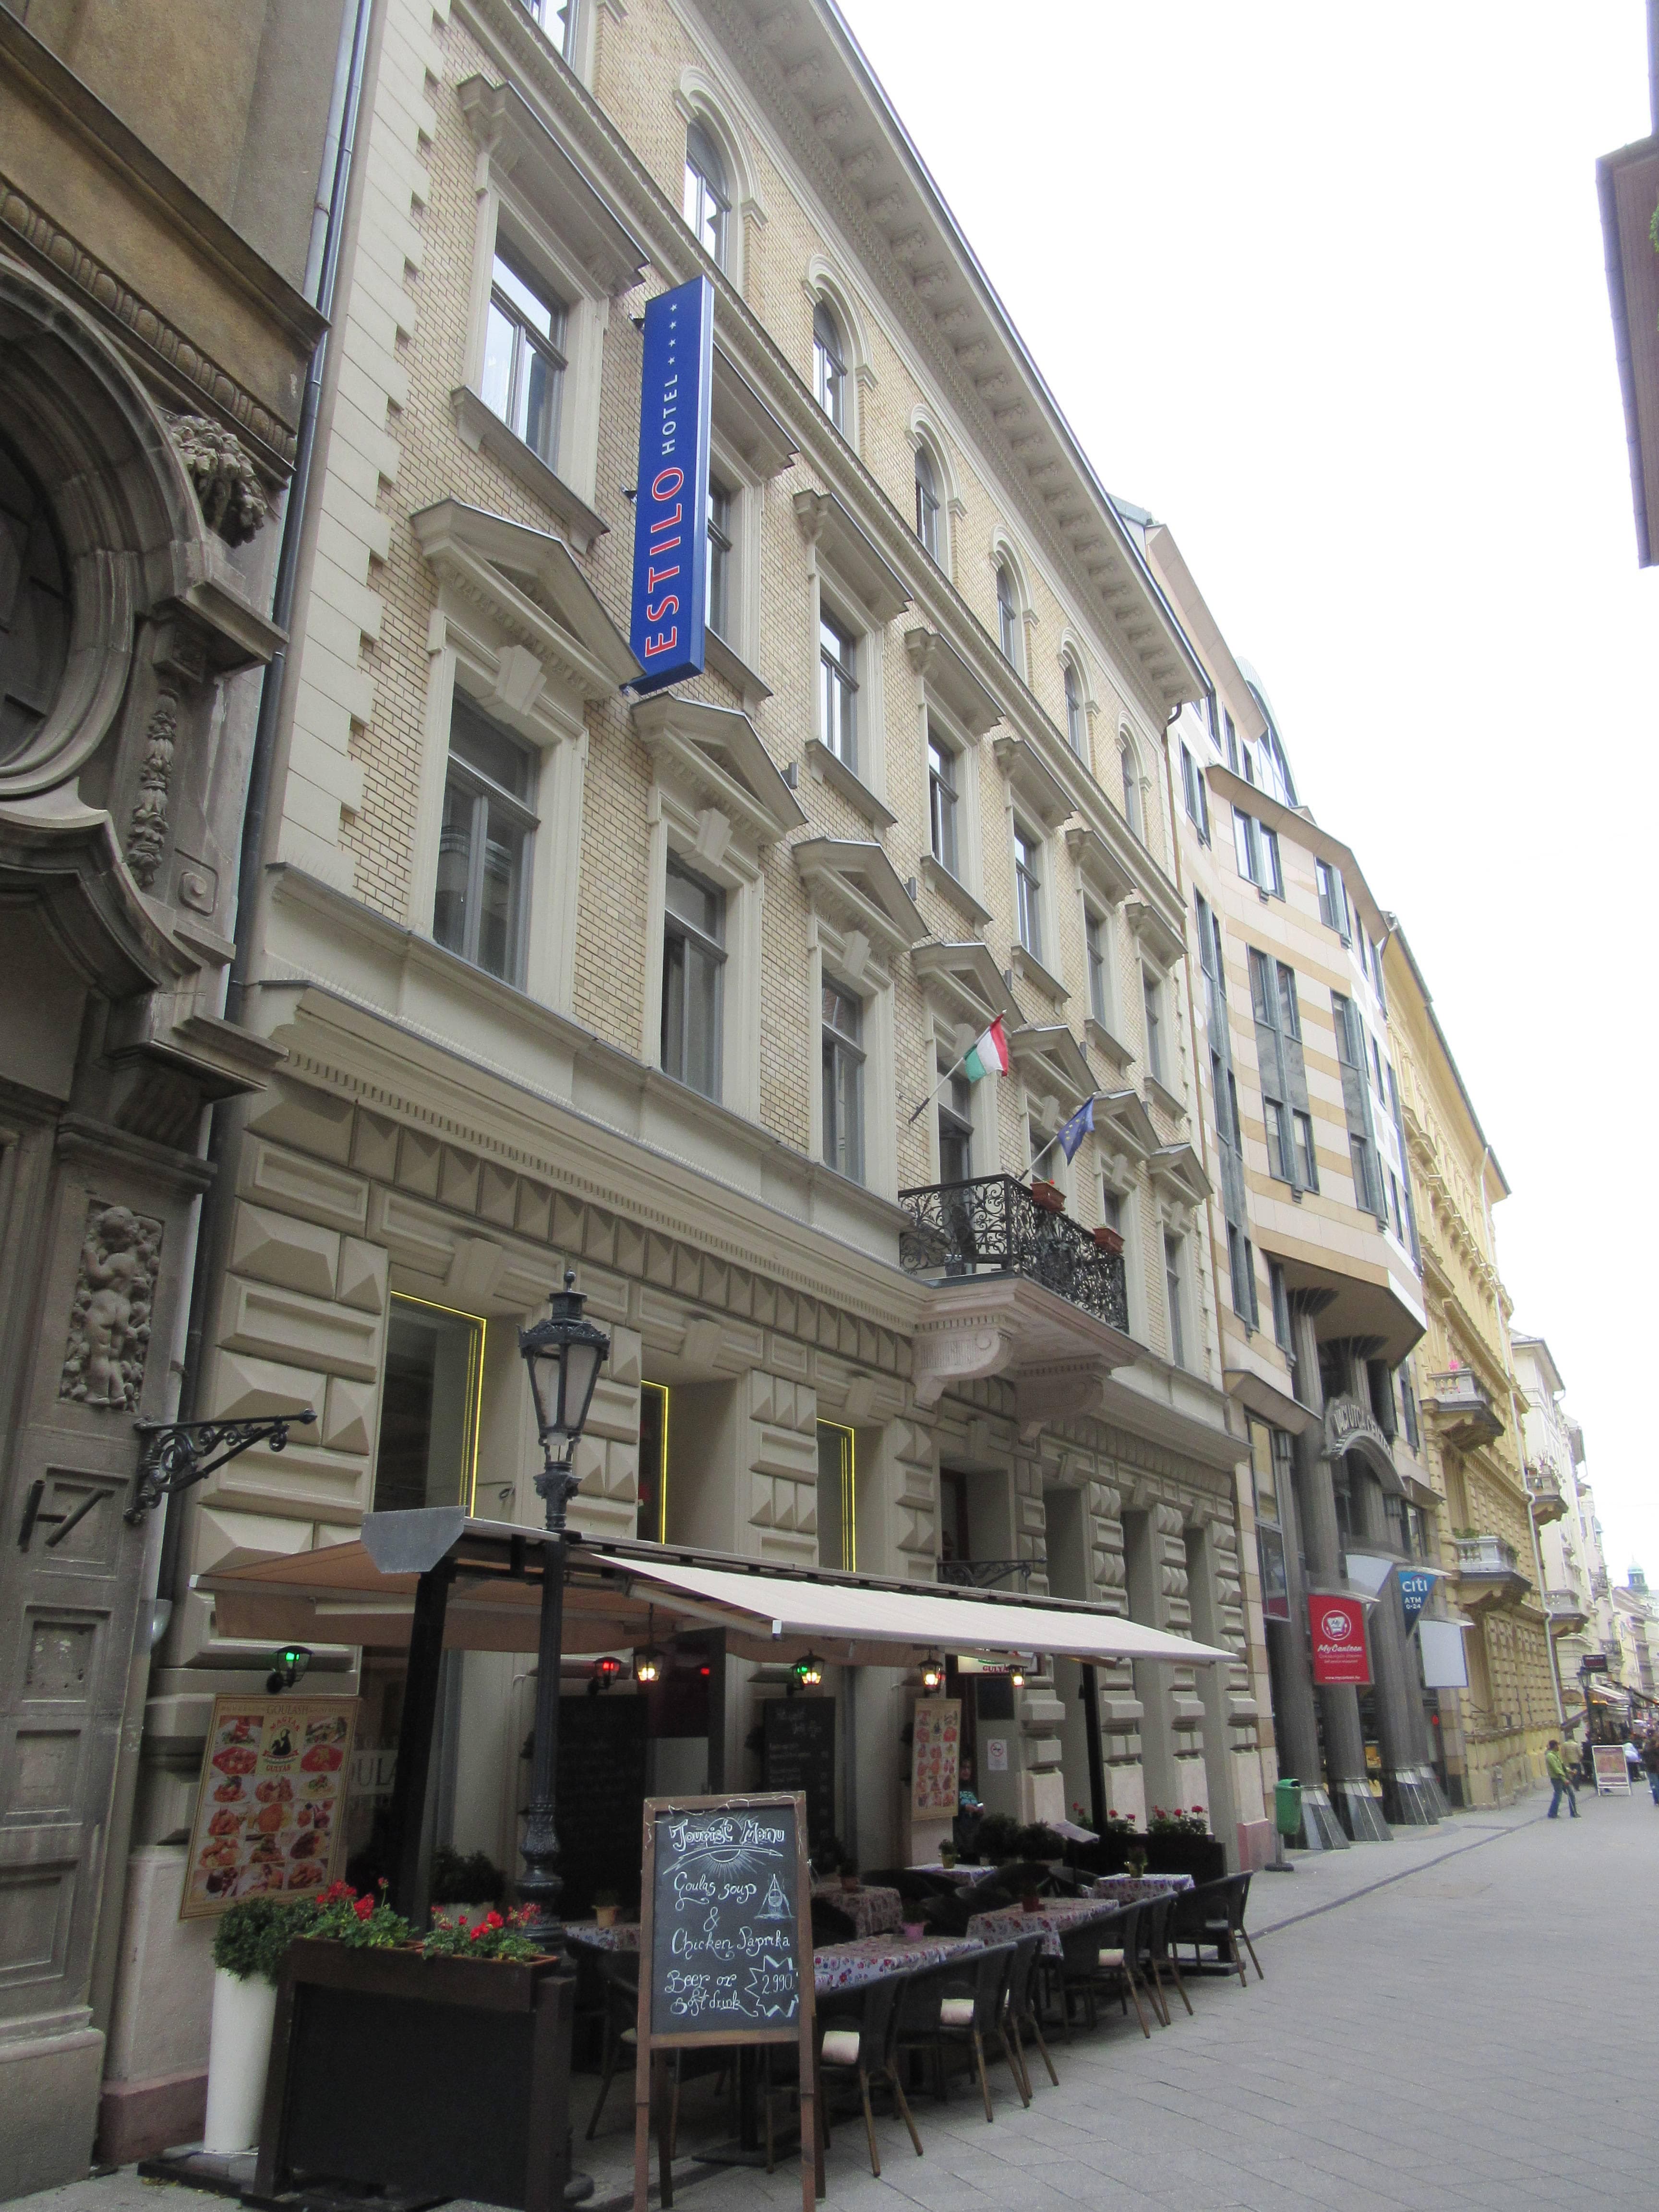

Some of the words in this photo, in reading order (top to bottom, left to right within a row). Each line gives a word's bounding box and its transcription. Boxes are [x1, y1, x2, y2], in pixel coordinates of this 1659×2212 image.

[662, 374, 678, 456] HOTEL
[645, 467, 684, 657] ESTILO
[267, 1705, 308, 1715] GOULASH
[270, 1716, 300, 1731] MAGYAR
[669, 1818, 733, 1852] Tourist
[740, 1819, 785, 1844] Menu
[674, 1872, 716, 1911] Goulas
[718, 1883, 757, 1904] soup
[703, 1906, 720, 1932] &
[672, 1928, 734, 1960] Chicken
[737, 1926, 790, 1956] Paprika
[665, 1970, 710, 1993] Beer
[717, 1974, 737, 1987] or
[709, 1990, 754, 2015] drink
